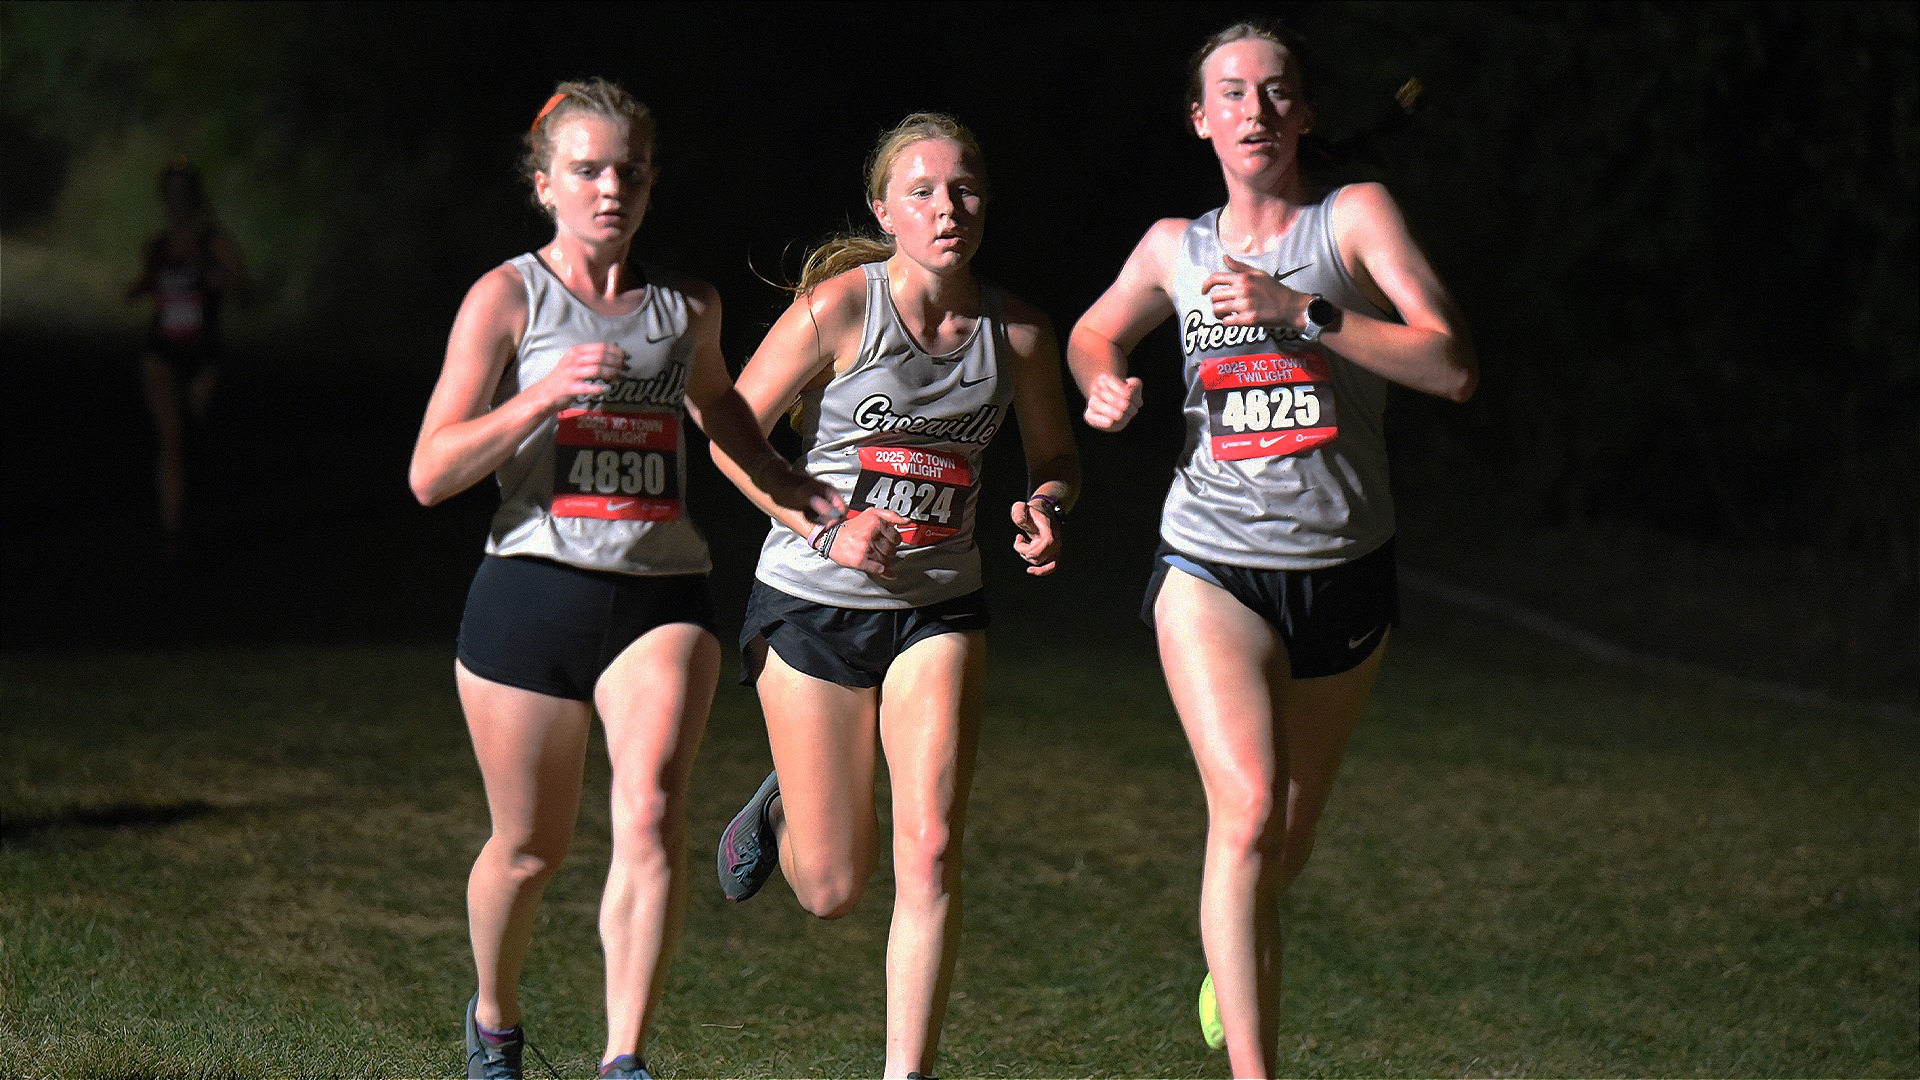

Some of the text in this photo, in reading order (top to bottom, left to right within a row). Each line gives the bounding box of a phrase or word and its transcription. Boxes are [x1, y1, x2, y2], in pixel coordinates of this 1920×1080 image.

[1184, 309, 1301, 356] Greenv
[1217, 361, 1248, 375] 2025
[1251, 360, 1268, 372] XC
[1235, 369, 1293, 384] TWILIGHT
[853, 392, 1000, 446] Greenville
[1222, 385, 1321, 433] 4825
[568, 449, 665, 496] 4830
[876, 451, 956, 470] 2025 XC TOWN
[891, 462, 944, 479] TWILIGHT
[865, 476, 956, 525] 4824
